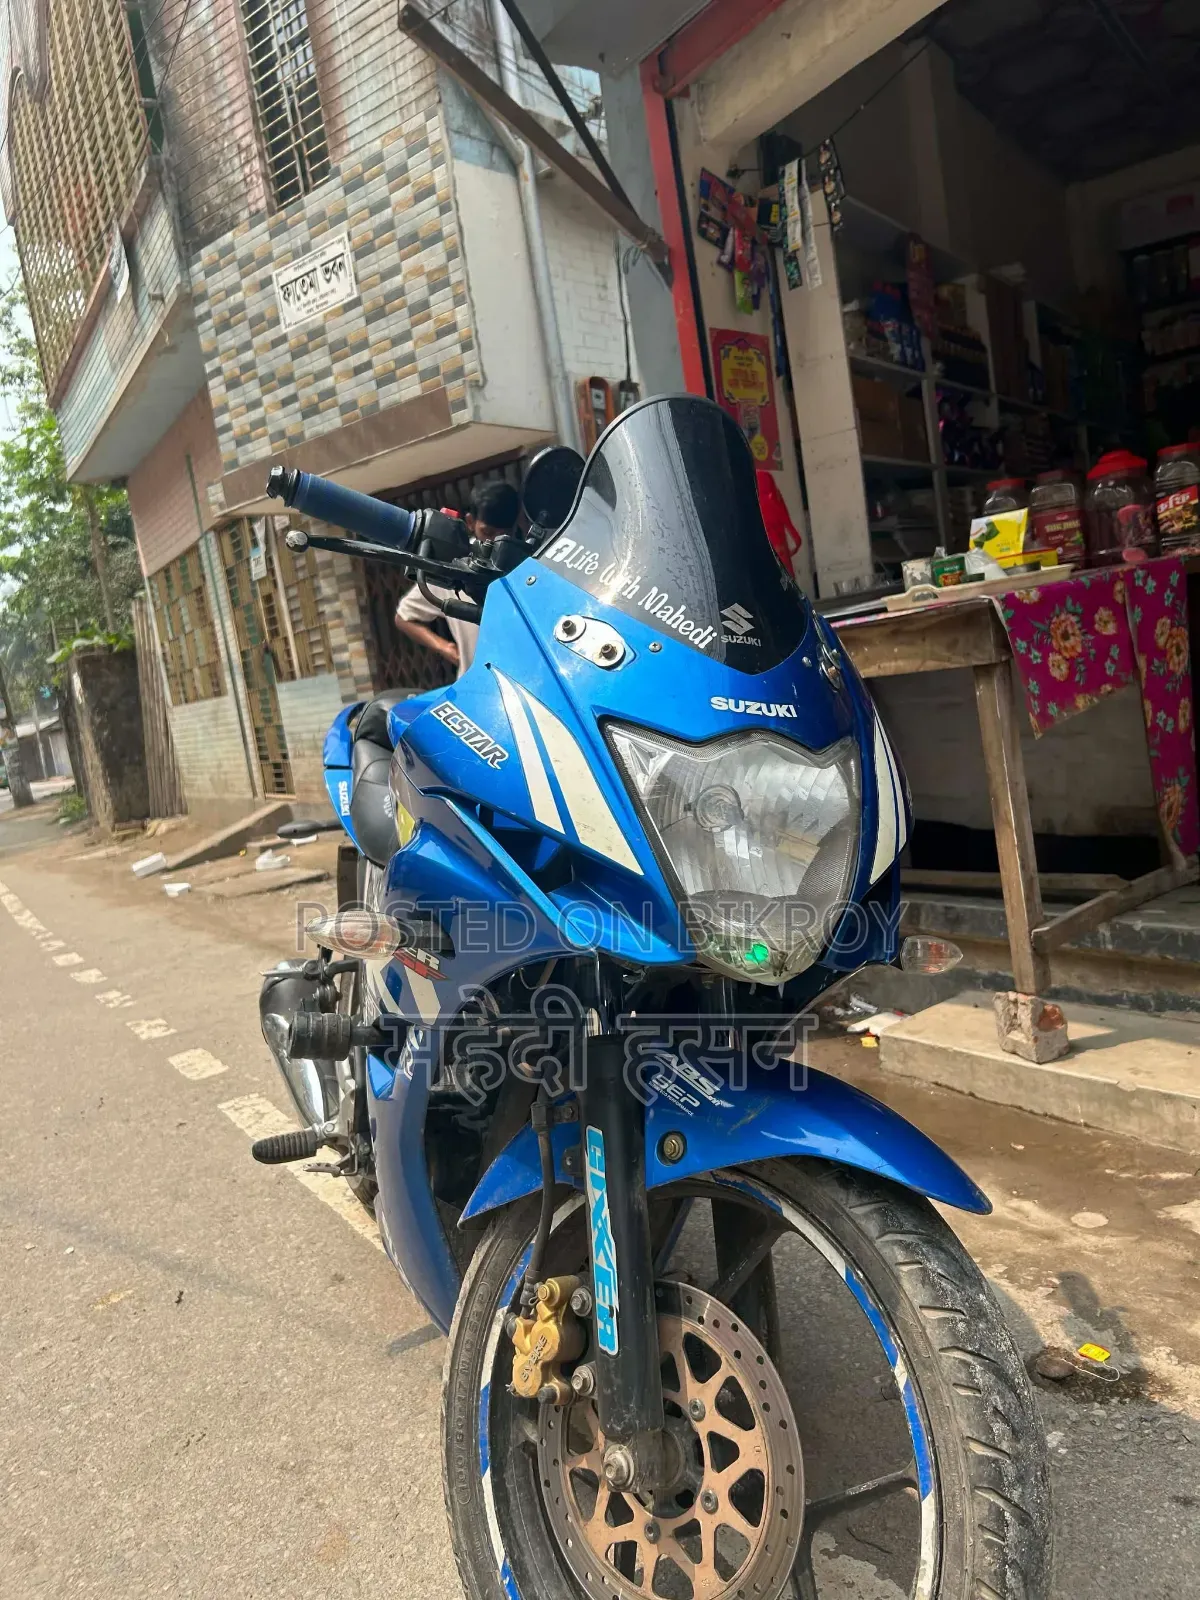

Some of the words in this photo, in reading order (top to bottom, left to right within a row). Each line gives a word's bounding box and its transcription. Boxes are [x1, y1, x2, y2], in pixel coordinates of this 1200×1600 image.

[280, 267, 320, 306] ফাতেমা
[566, 545, 601, 577] Life
[638, 586, 718, 650] Mahedi
[720, 634, 762, 647] SUZUKI
[710, 696, 798, 718] SUZUKI
[430, 701, 509, 769] ECSTAR
[338, 780, 351, 817] SUZUKI
[652, 1074, 701, 1107] SEP
[654, 1053, 721, 1096] ABS
[585, 1125, 620, 1356] GIXXER
[519, 1334, 549, 1384] BYBRE
